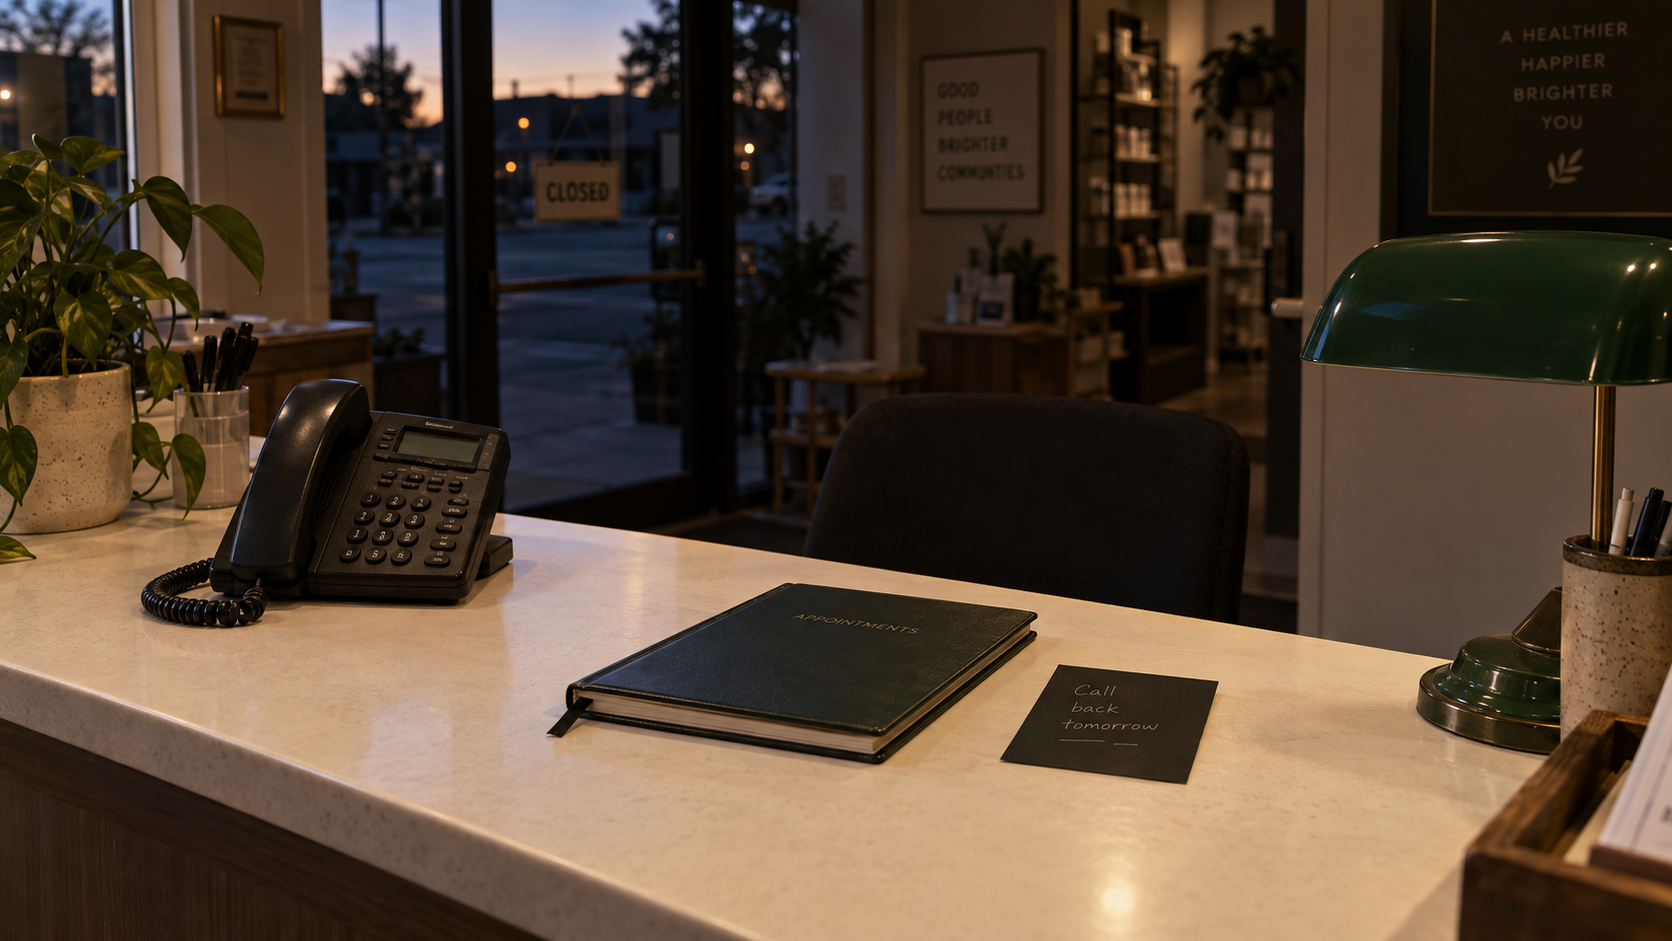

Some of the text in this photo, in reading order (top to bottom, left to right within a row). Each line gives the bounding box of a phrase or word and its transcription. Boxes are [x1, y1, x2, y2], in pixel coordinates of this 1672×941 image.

[1500, 21, 1628, 44] A HEALTHIER
[1521, 53, 1605, 71] HAPPIER
[937, 81, 980, 99] GOOD
[1513, 83, 1613, 102] BRIGHTER
[937, 108, 993, 126] PEOPLE
[1541, 115, 1583, 130] YOU
[938, 136, 1008, 153] BRIGHTER
[546, 181, 609, 203] CLOSED
[792, 613, 919, 634] APPOINTMENTS
[1074, 684, 1117, 697] Call
[1071, 701, 1119, 714] back
[1061, 719, 1159, 731] tomorrow
